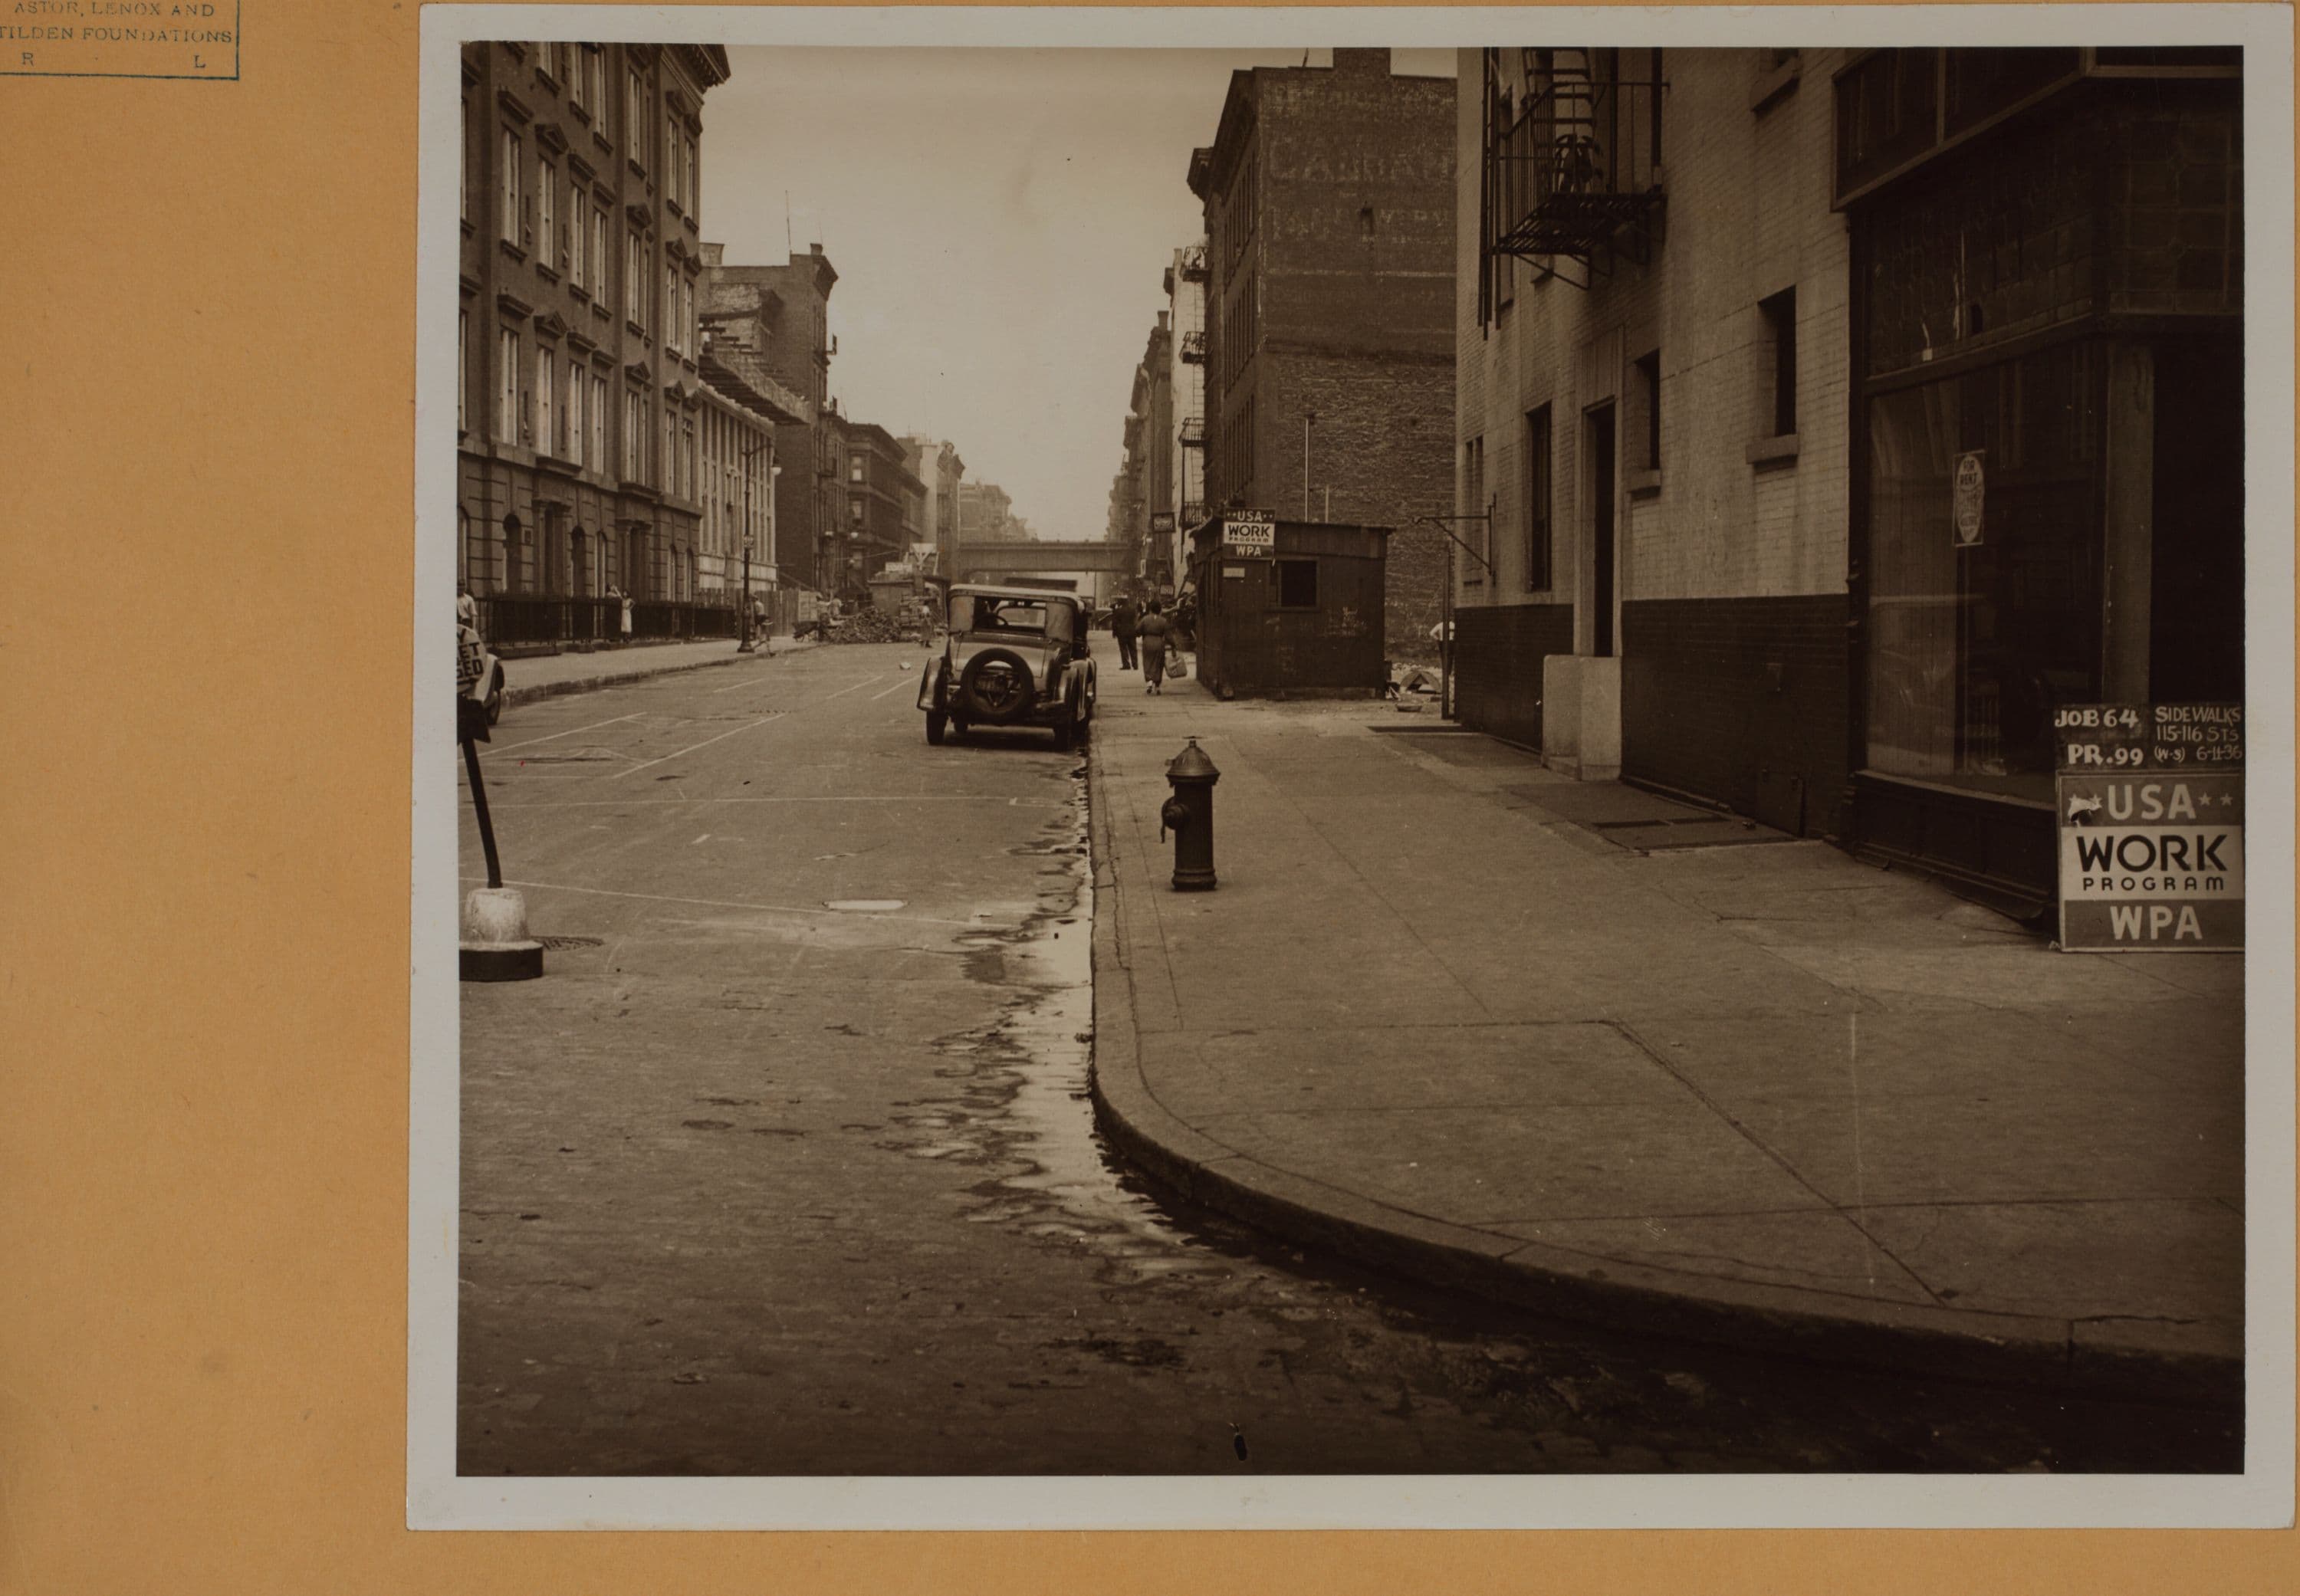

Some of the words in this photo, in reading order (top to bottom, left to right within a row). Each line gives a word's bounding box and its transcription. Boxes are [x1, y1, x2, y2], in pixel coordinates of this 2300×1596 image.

[15, 1, 84, 17] ASTOR,
[92, 2, 160, 16] LENOX
[172, 5, 215, 17] AND
[0, 26, 74, 39] TILDEN
[83, 28, 232, 43] FOUNDATIONS
[22, 52, 34, 67] R
[195, 55, 206, 69] L
[1963, 459, 1976, 471] FOR
[1960, 473, 1978, 485] RENT
[1237, 511, 1263, 522] USA
[1228, 524, 1270, 537] WORK
[1236, 545, 1262, 557] WPA
[2055, 708, 2100, 727] JOB
[2103, 708, 2139, 728] 64
[2155, 705, 2242, 727] SIDEWALKS
[2157, 724, 2203, 742] 115-116
[2108, 784, 2197, 820] USA
[2076, 834, 2229, 872] WORK
[2083, 876, 2225, 892] PROGRAM
[2110, 905, 2203, 941] WPA
